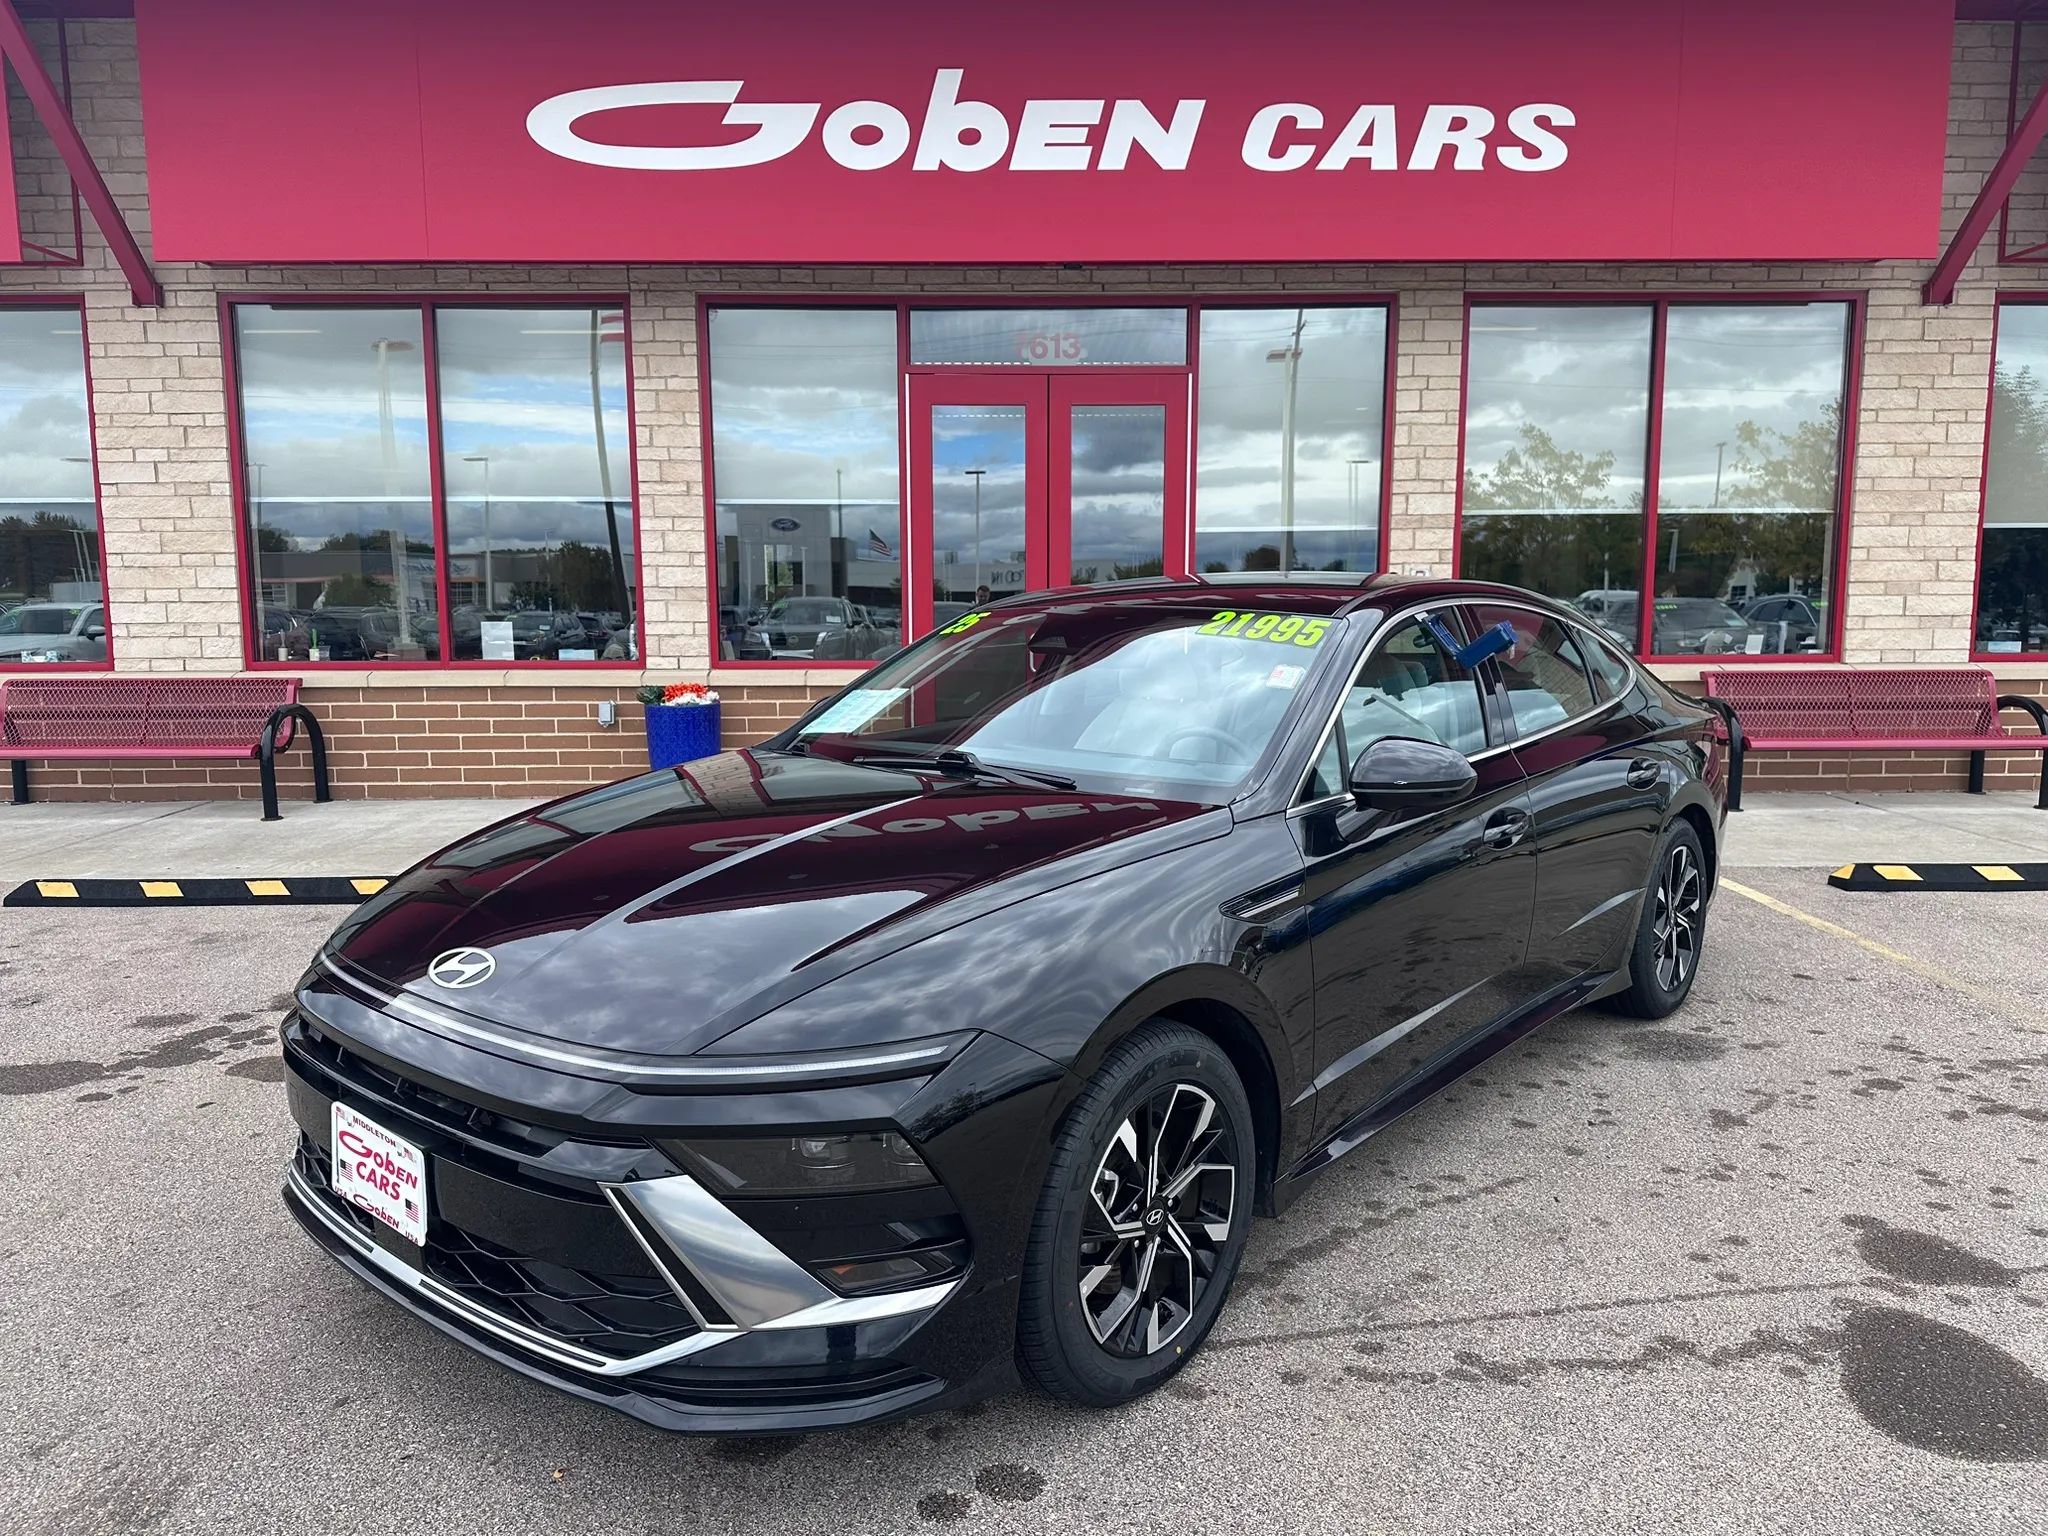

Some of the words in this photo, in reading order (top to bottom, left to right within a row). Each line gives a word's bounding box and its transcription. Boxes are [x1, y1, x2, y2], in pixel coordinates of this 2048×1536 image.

[1242, 102, 1576, 172] CARS
[1197, 610, 1332, 646] 21995
[352, 1115, 396, 1147] MIDDLETON
[356, 1160, 401, 1200] CARS
